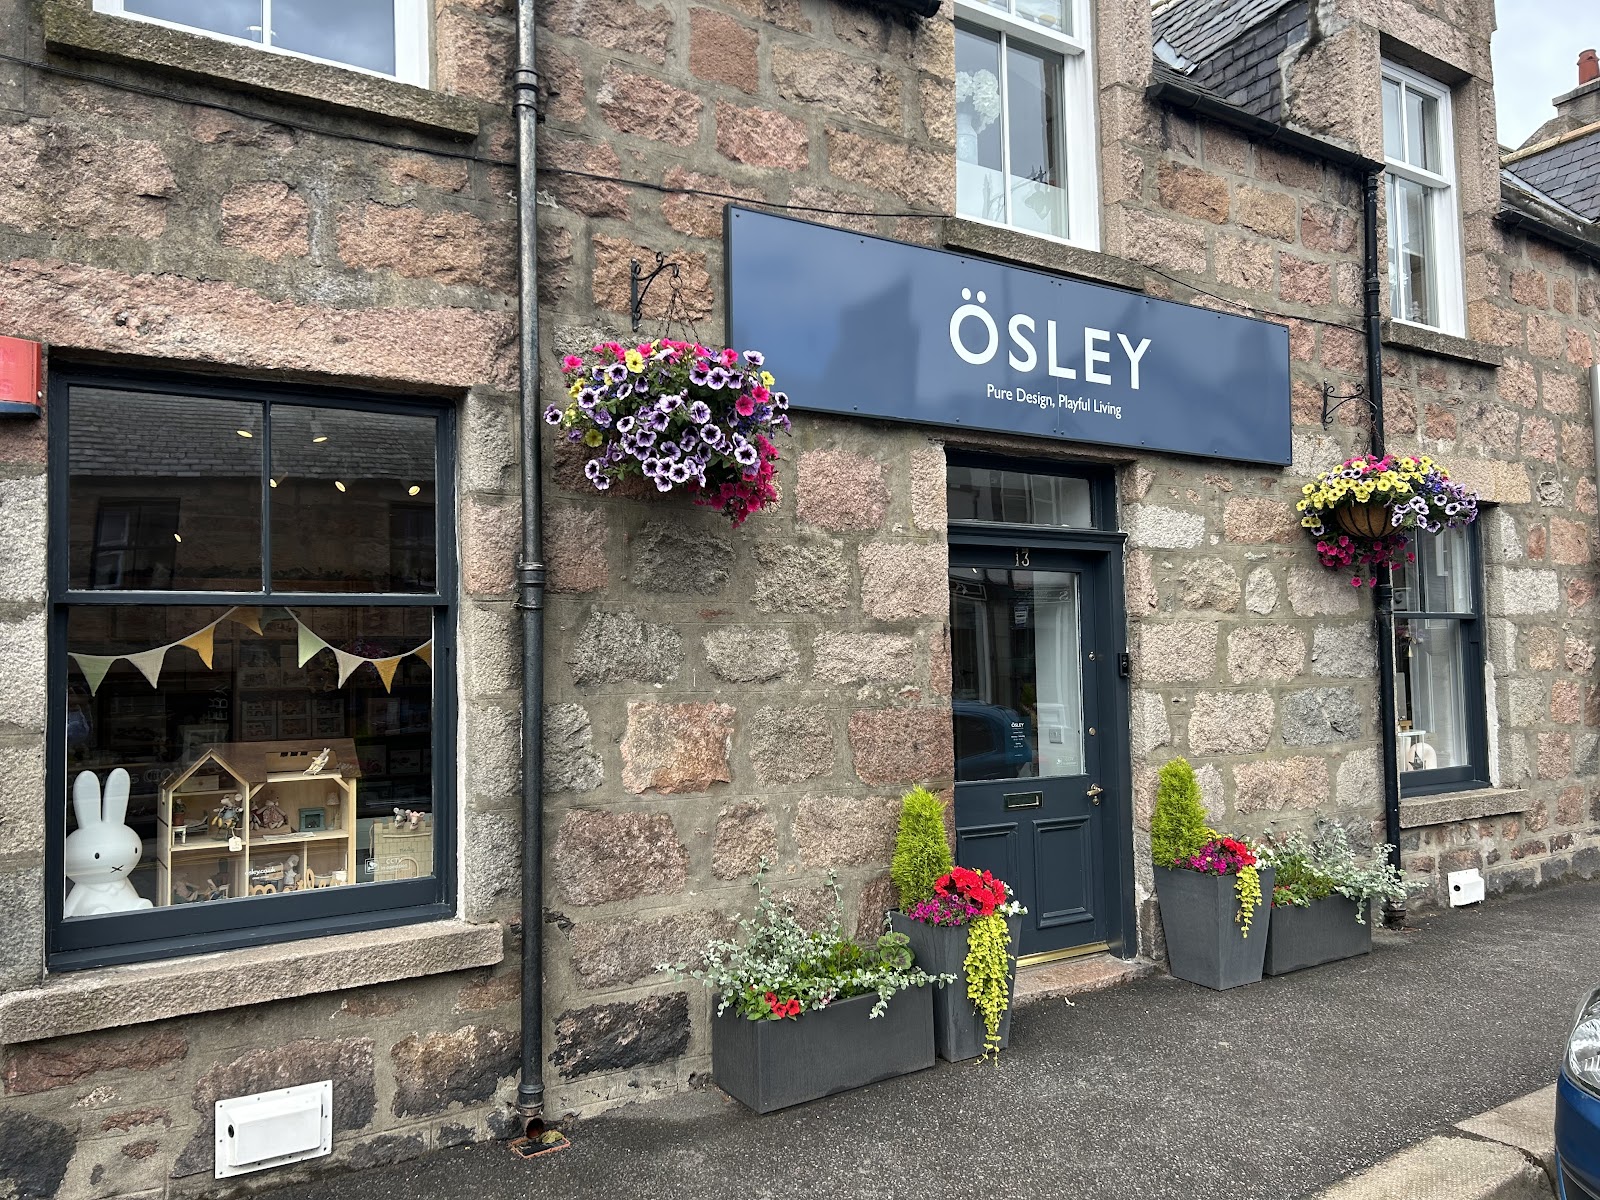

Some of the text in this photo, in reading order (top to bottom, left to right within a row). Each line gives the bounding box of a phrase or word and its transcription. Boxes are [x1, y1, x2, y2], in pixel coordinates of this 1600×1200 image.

[949, 287, 1152, 390] ÖSLEY
[987, 383, 1122, 419] Pure Design, Playful Living
[1015, 548, 1030, 567] 13
